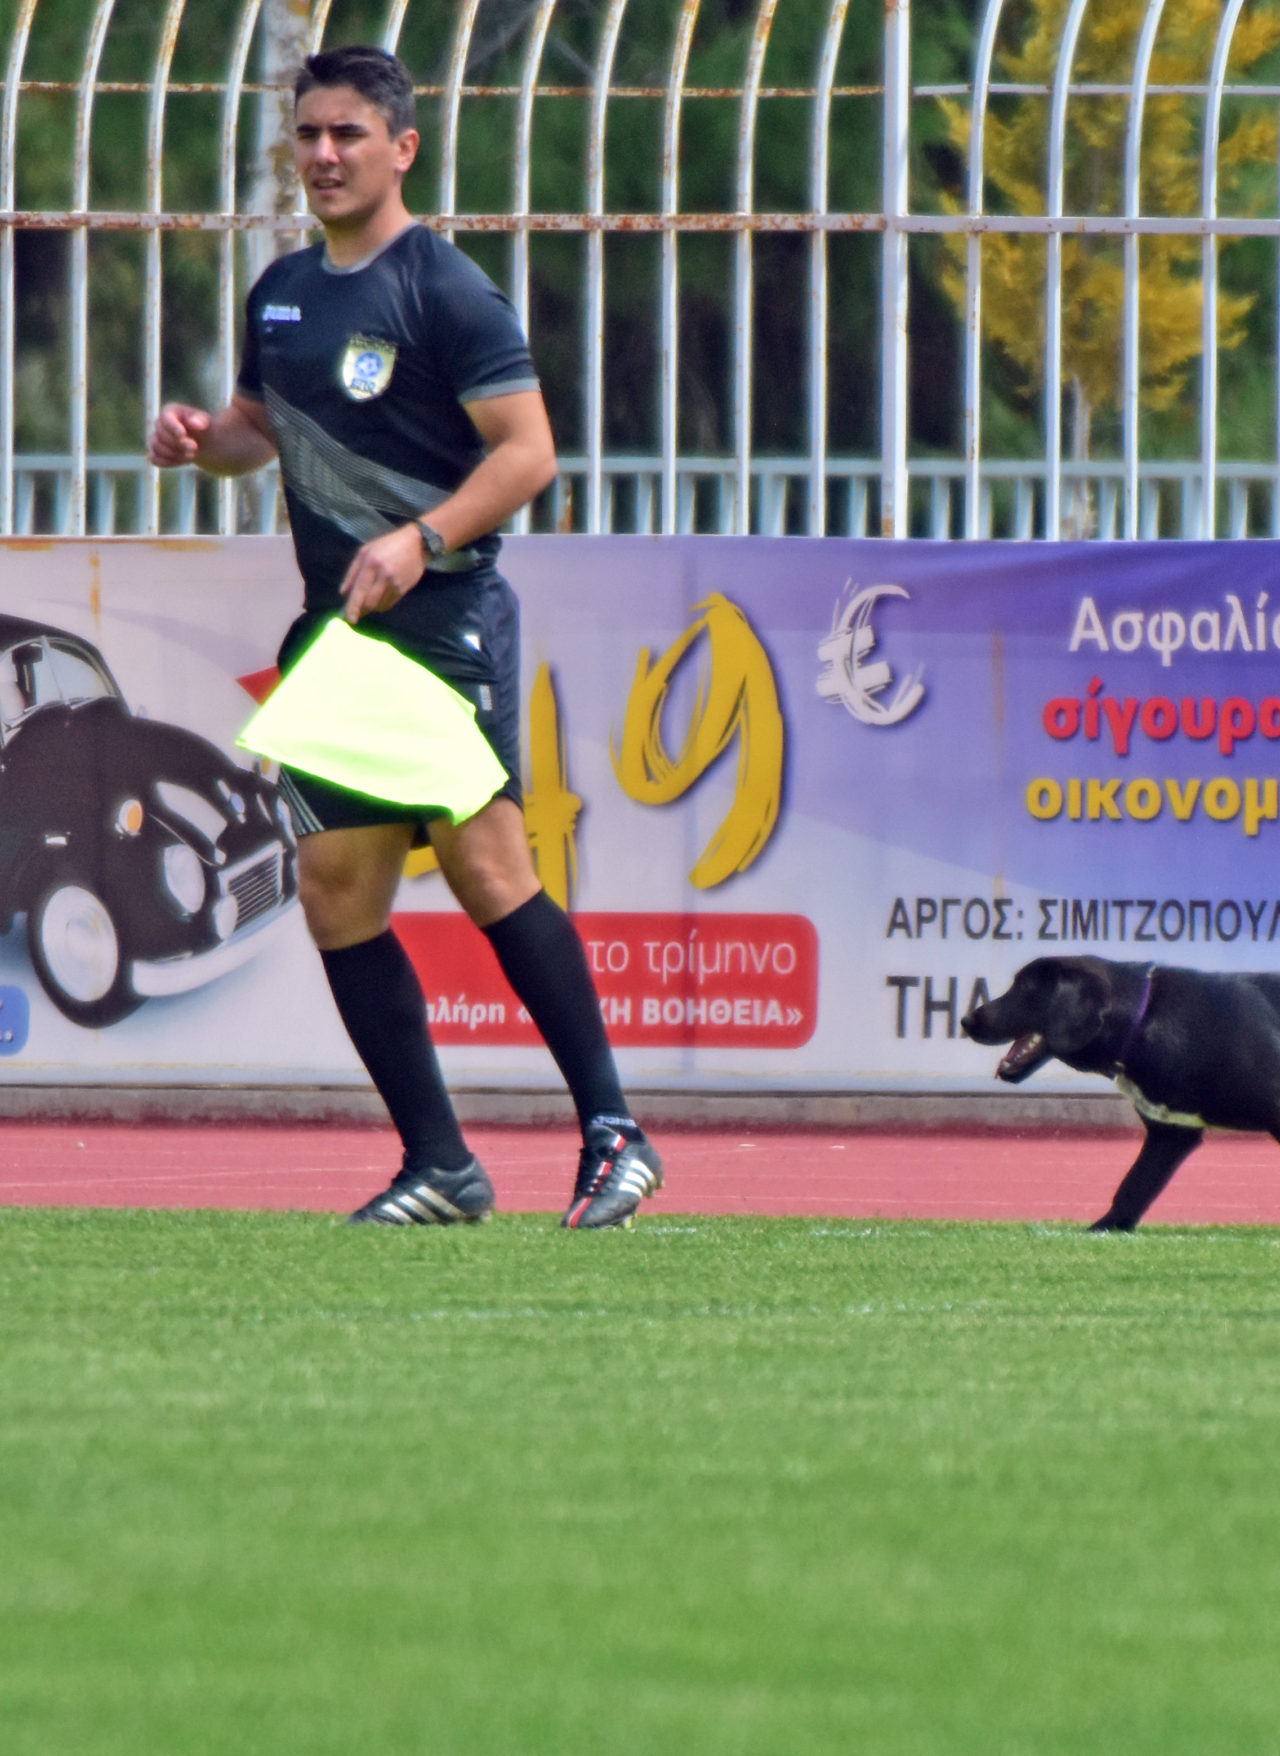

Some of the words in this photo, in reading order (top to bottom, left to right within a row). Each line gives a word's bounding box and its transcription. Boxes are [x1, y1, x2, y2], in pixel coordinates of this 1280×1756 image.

[886, 897, 1024, 940] ΑΡΓΟΣ:
[643, 927, 797, 985] τρίμηνο
[642, 996, 803, 1026] ΒΟΗΘΕΙΑ»
